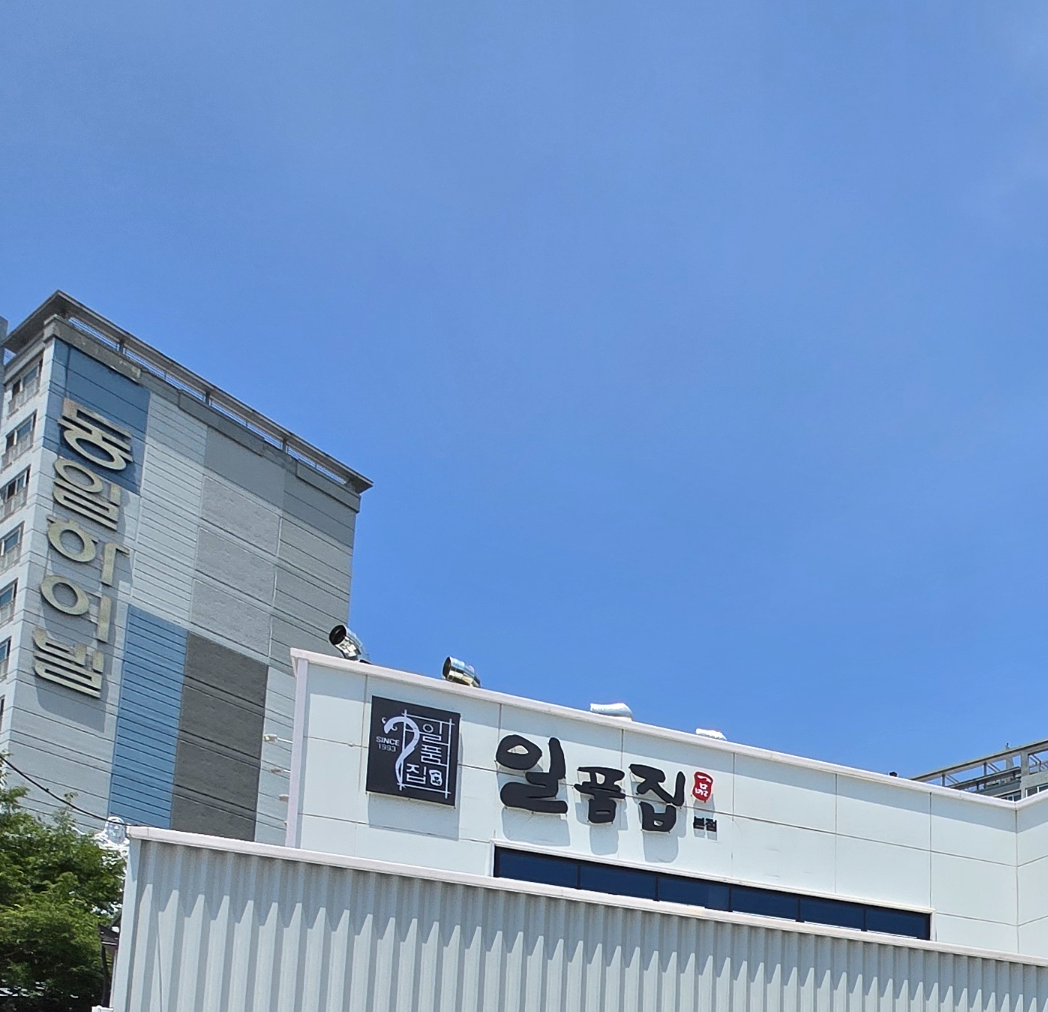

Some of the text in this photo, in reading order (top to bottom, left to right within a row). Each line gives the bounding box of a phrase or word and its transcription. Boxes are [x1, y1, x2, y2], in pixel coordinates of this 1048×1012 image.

[32, 398, 134, 699] 동일하이빌
[376, 736, 400, 747] SINCE
[495, 734, 686, 832] 일품집
